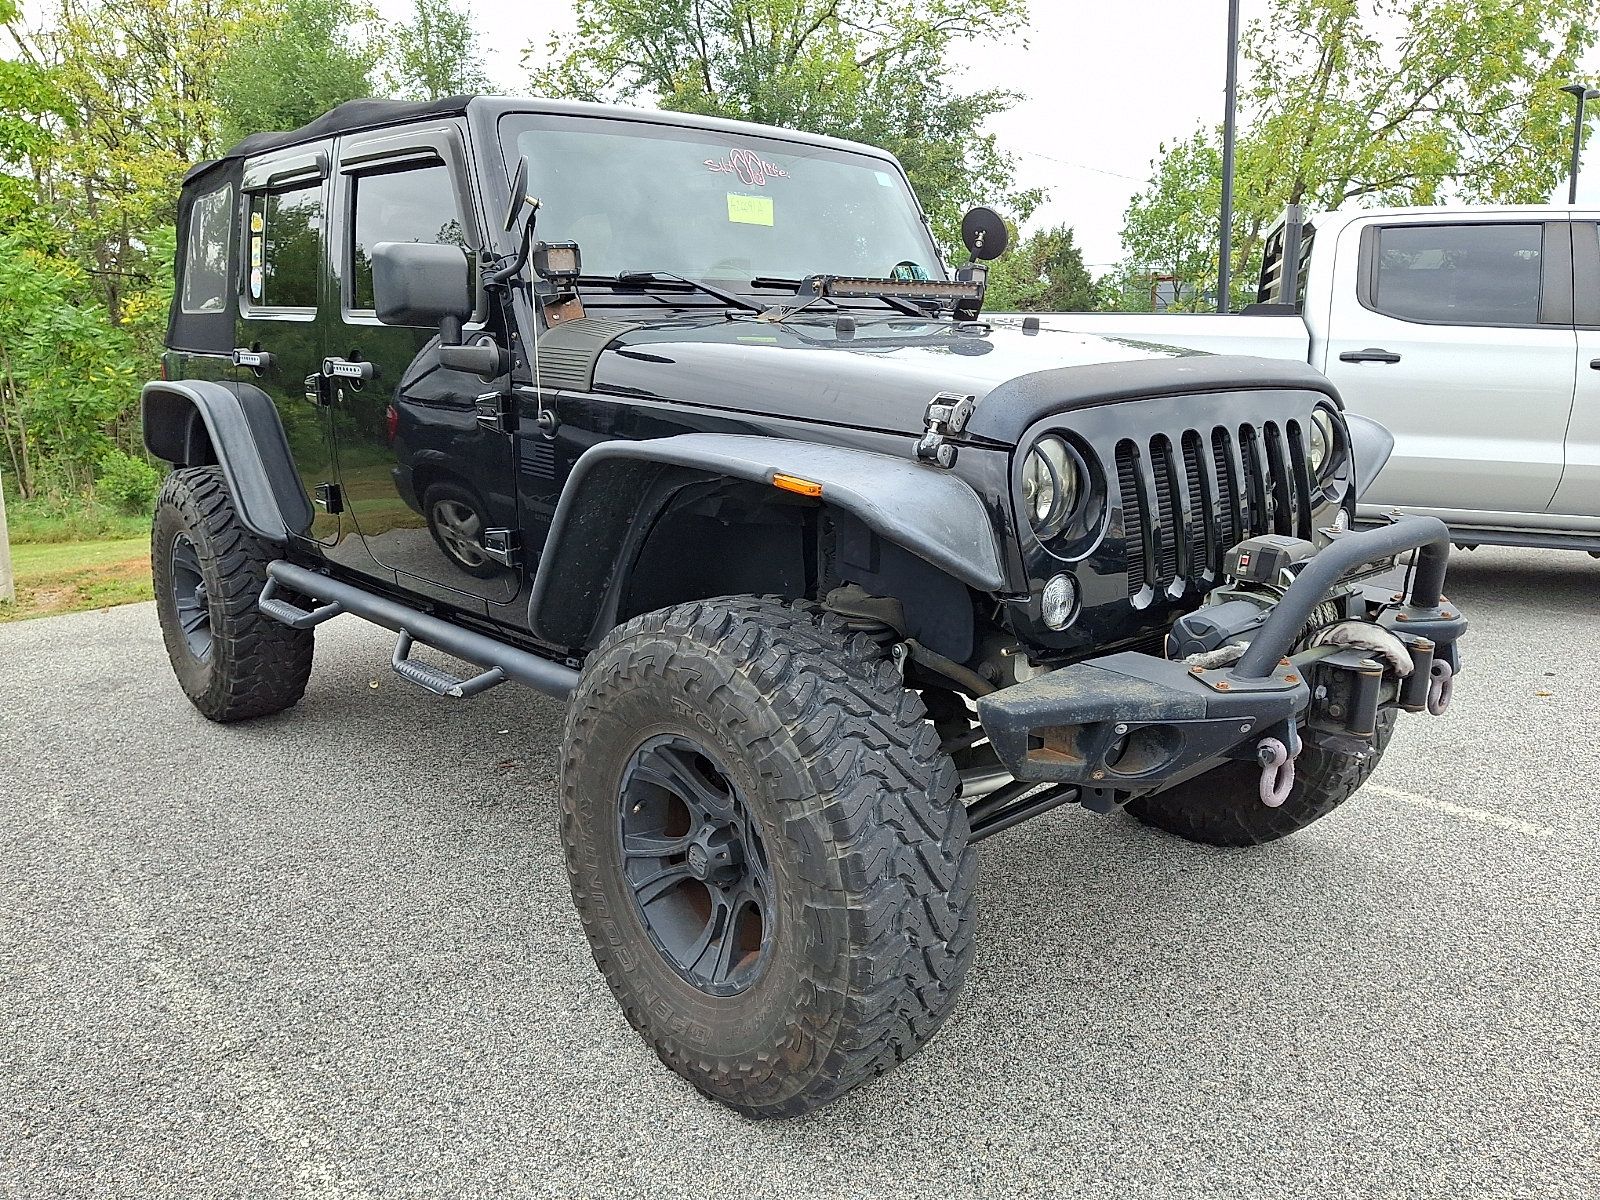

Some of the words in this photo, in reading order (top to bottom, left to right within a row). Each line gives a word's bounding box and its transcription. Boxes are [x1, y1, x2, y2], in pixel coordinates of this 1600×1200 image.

[671, 696, 758, 790] TOYO
[578, 785, 636, 974] COUNTRY
[636, 980, 712, 1047] OPEN
